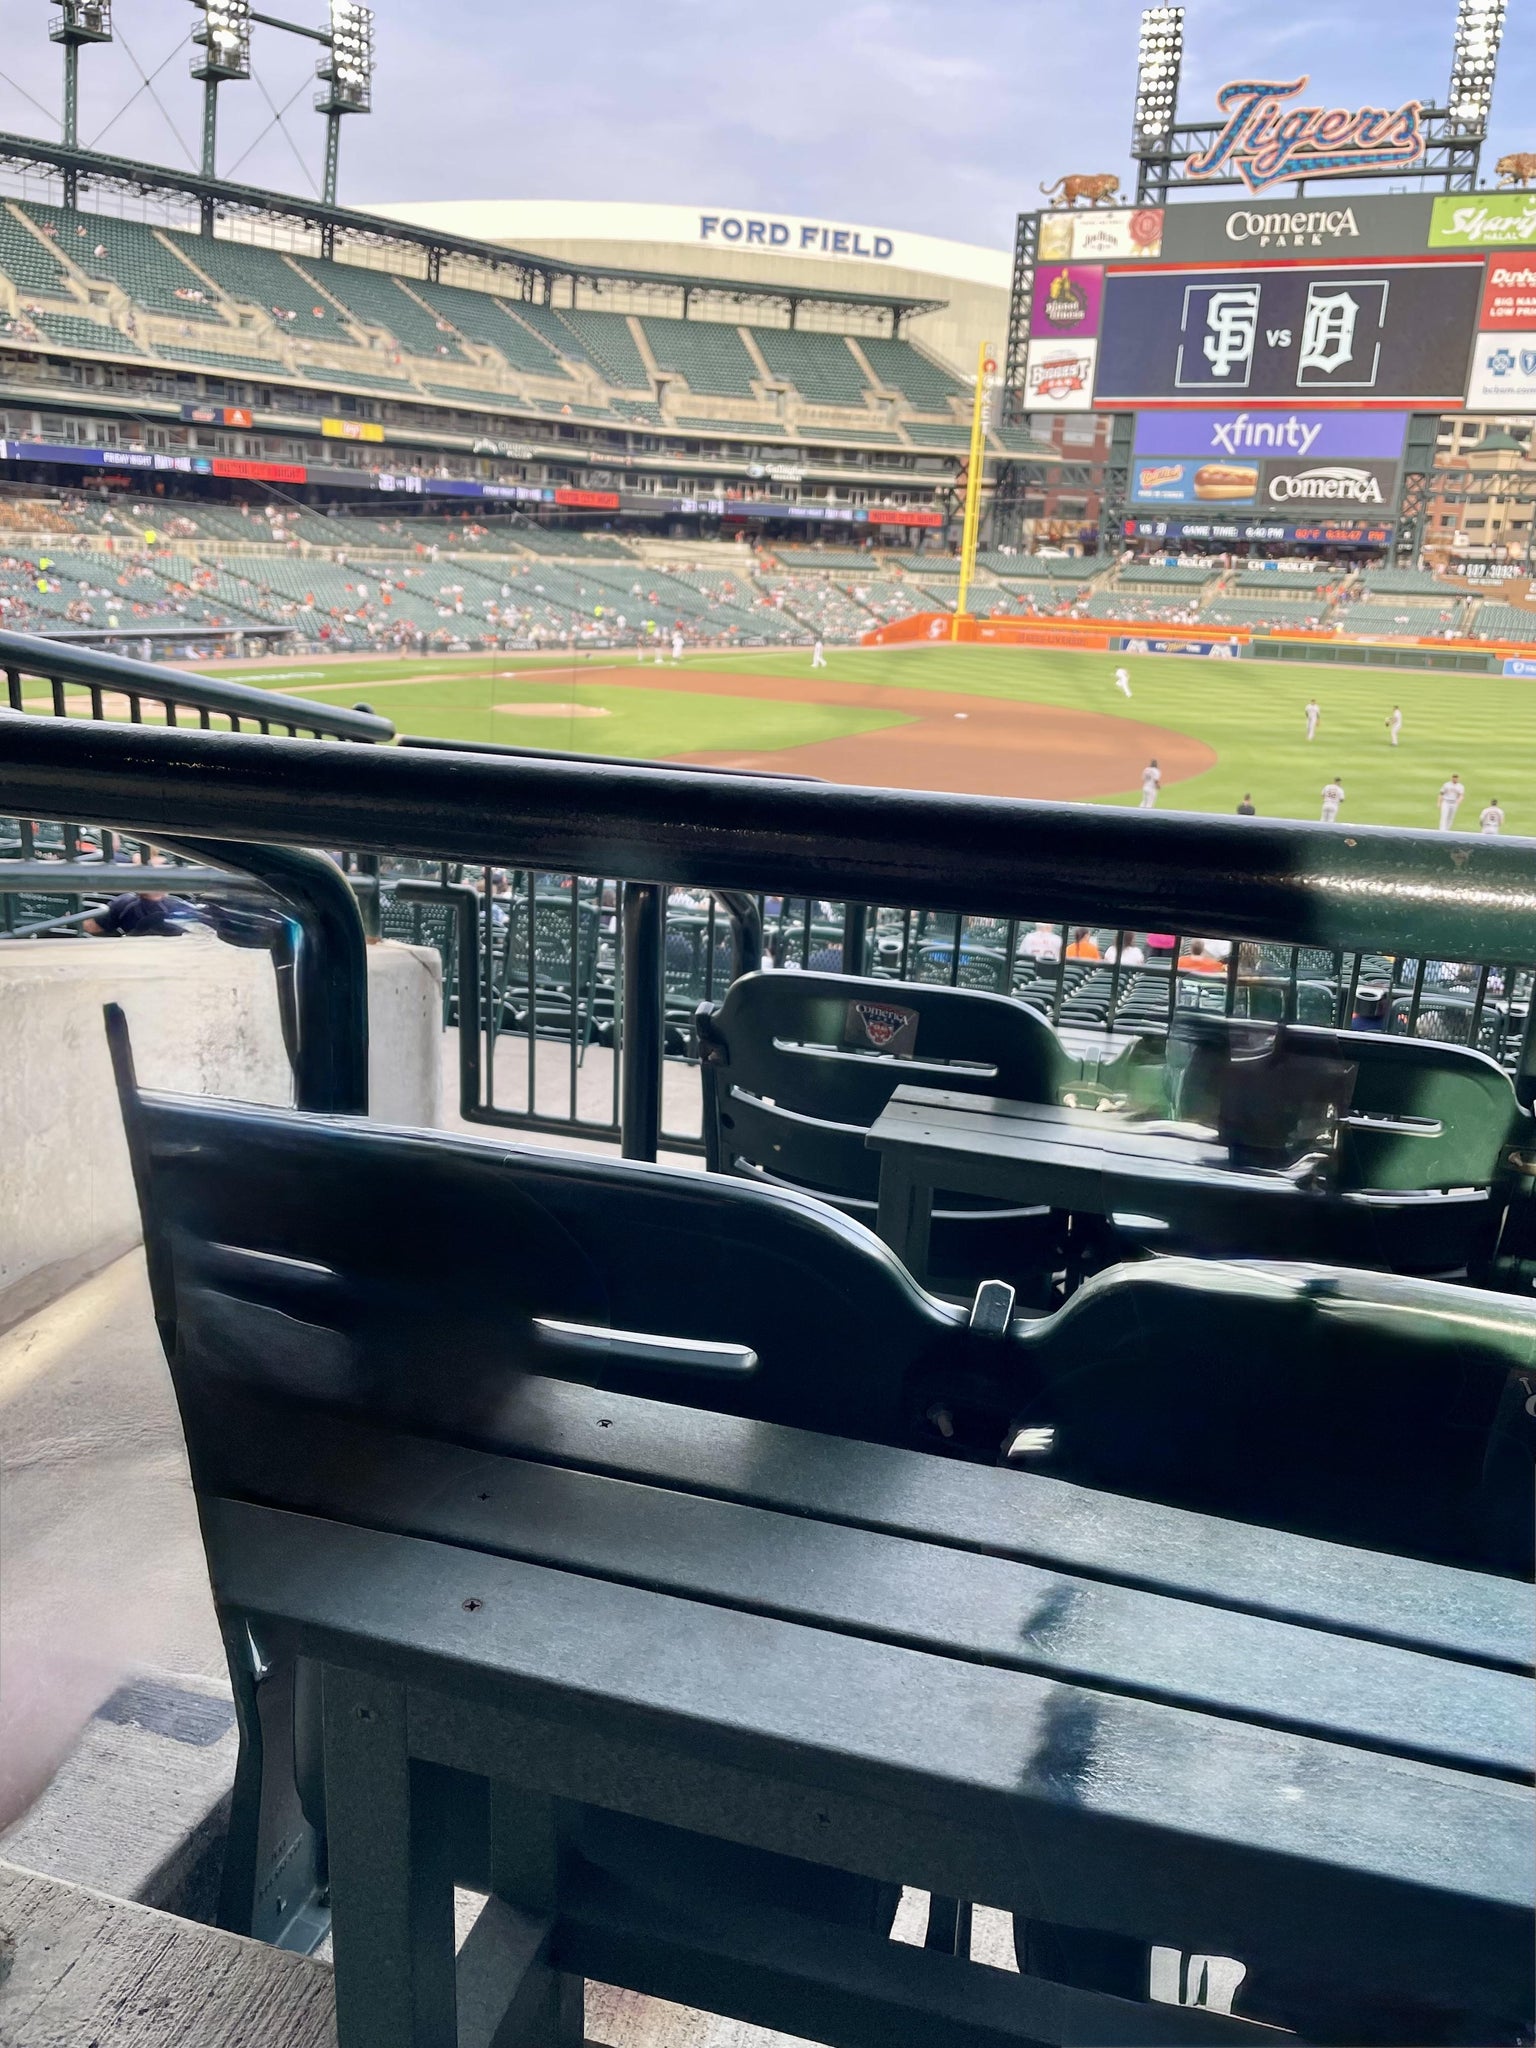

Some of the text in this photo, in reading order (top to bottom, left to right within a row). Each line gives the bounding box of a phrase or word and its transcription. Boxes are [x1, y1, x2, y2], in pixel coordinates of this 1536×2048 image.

[1185, 75, 1425, 194] Tigers
[700, 215, 895, 260] FORD FIELD
[1225, 207, 1360, 241] Comerica
[1259, 233, 1323, 248] PARK
[1210, 413, 1323, 456] xfinity
[1268, 473, 1386, 503] Comerica
